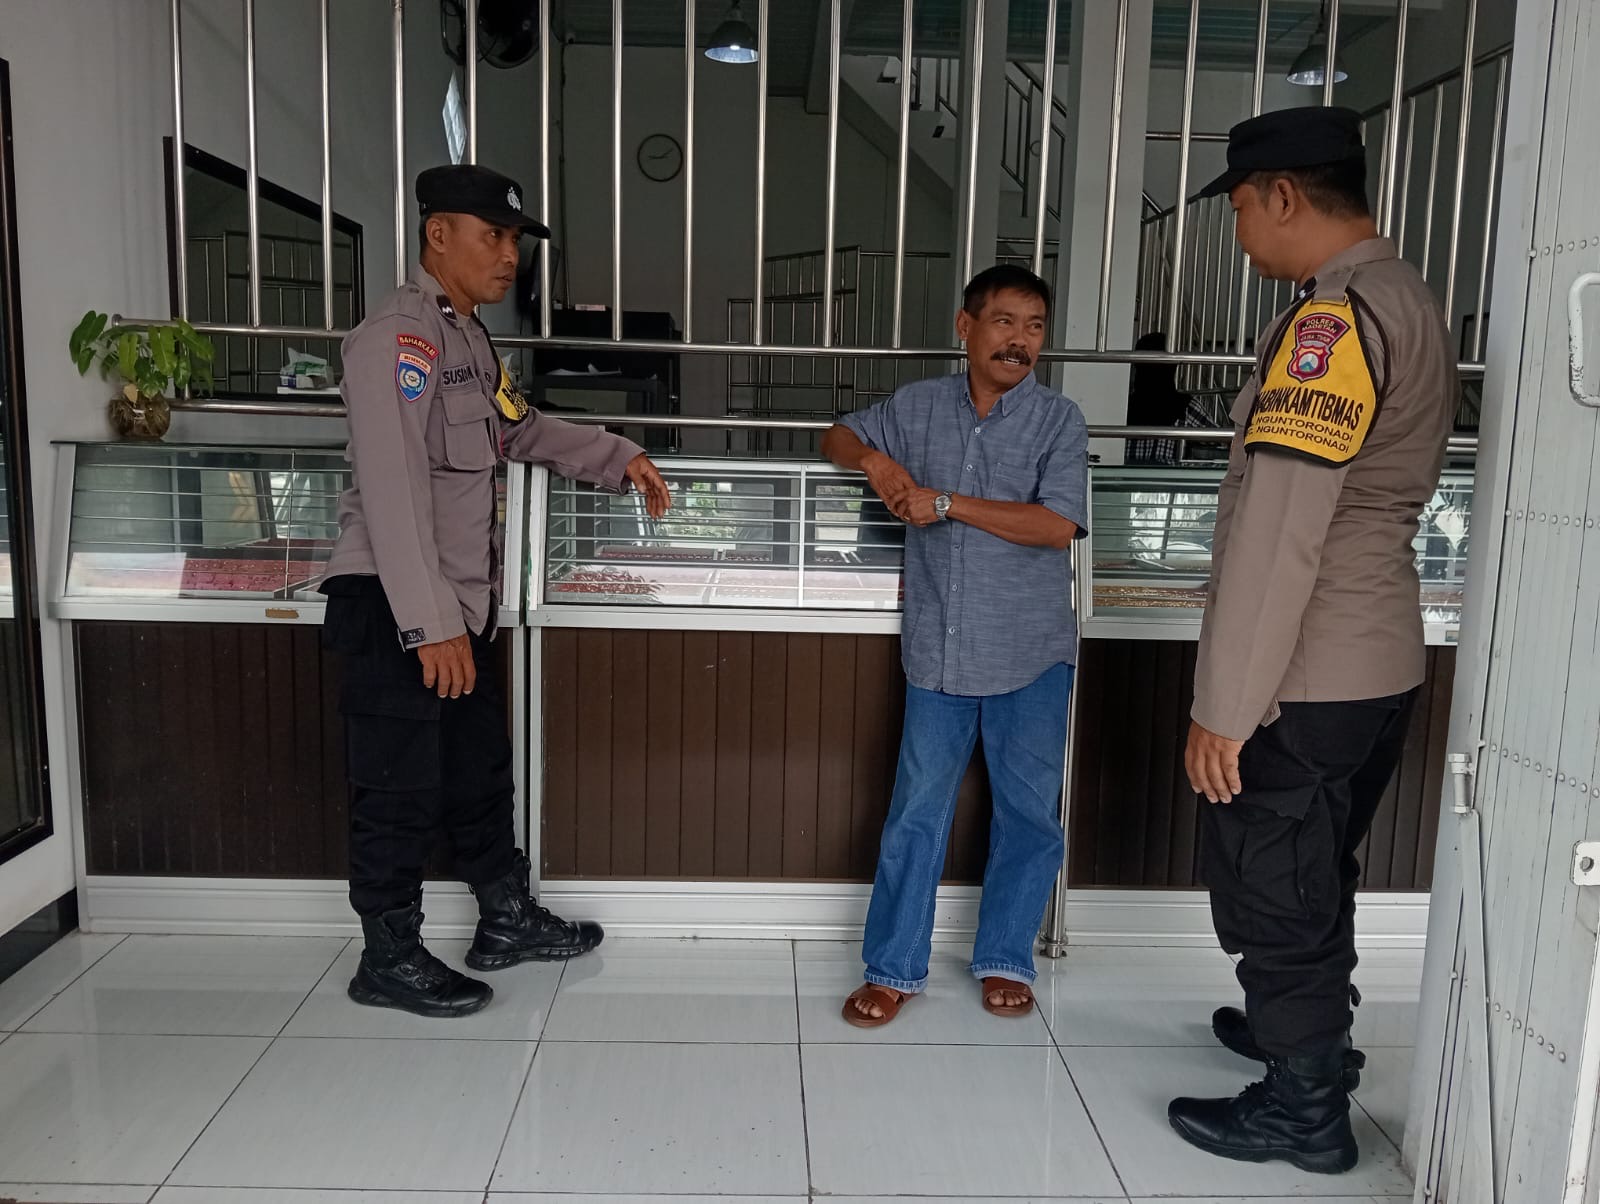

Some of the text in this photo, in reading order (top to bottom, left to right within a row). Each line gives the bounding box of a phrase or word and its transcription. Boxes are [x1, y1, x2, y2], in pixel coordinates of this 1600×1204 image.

[1306, 318, 1335, 327] POLRES
[1256, 416, 1353, 443] NGUNTORONADI
[1256, 426, 1349, 453] NGUNTORONADI
